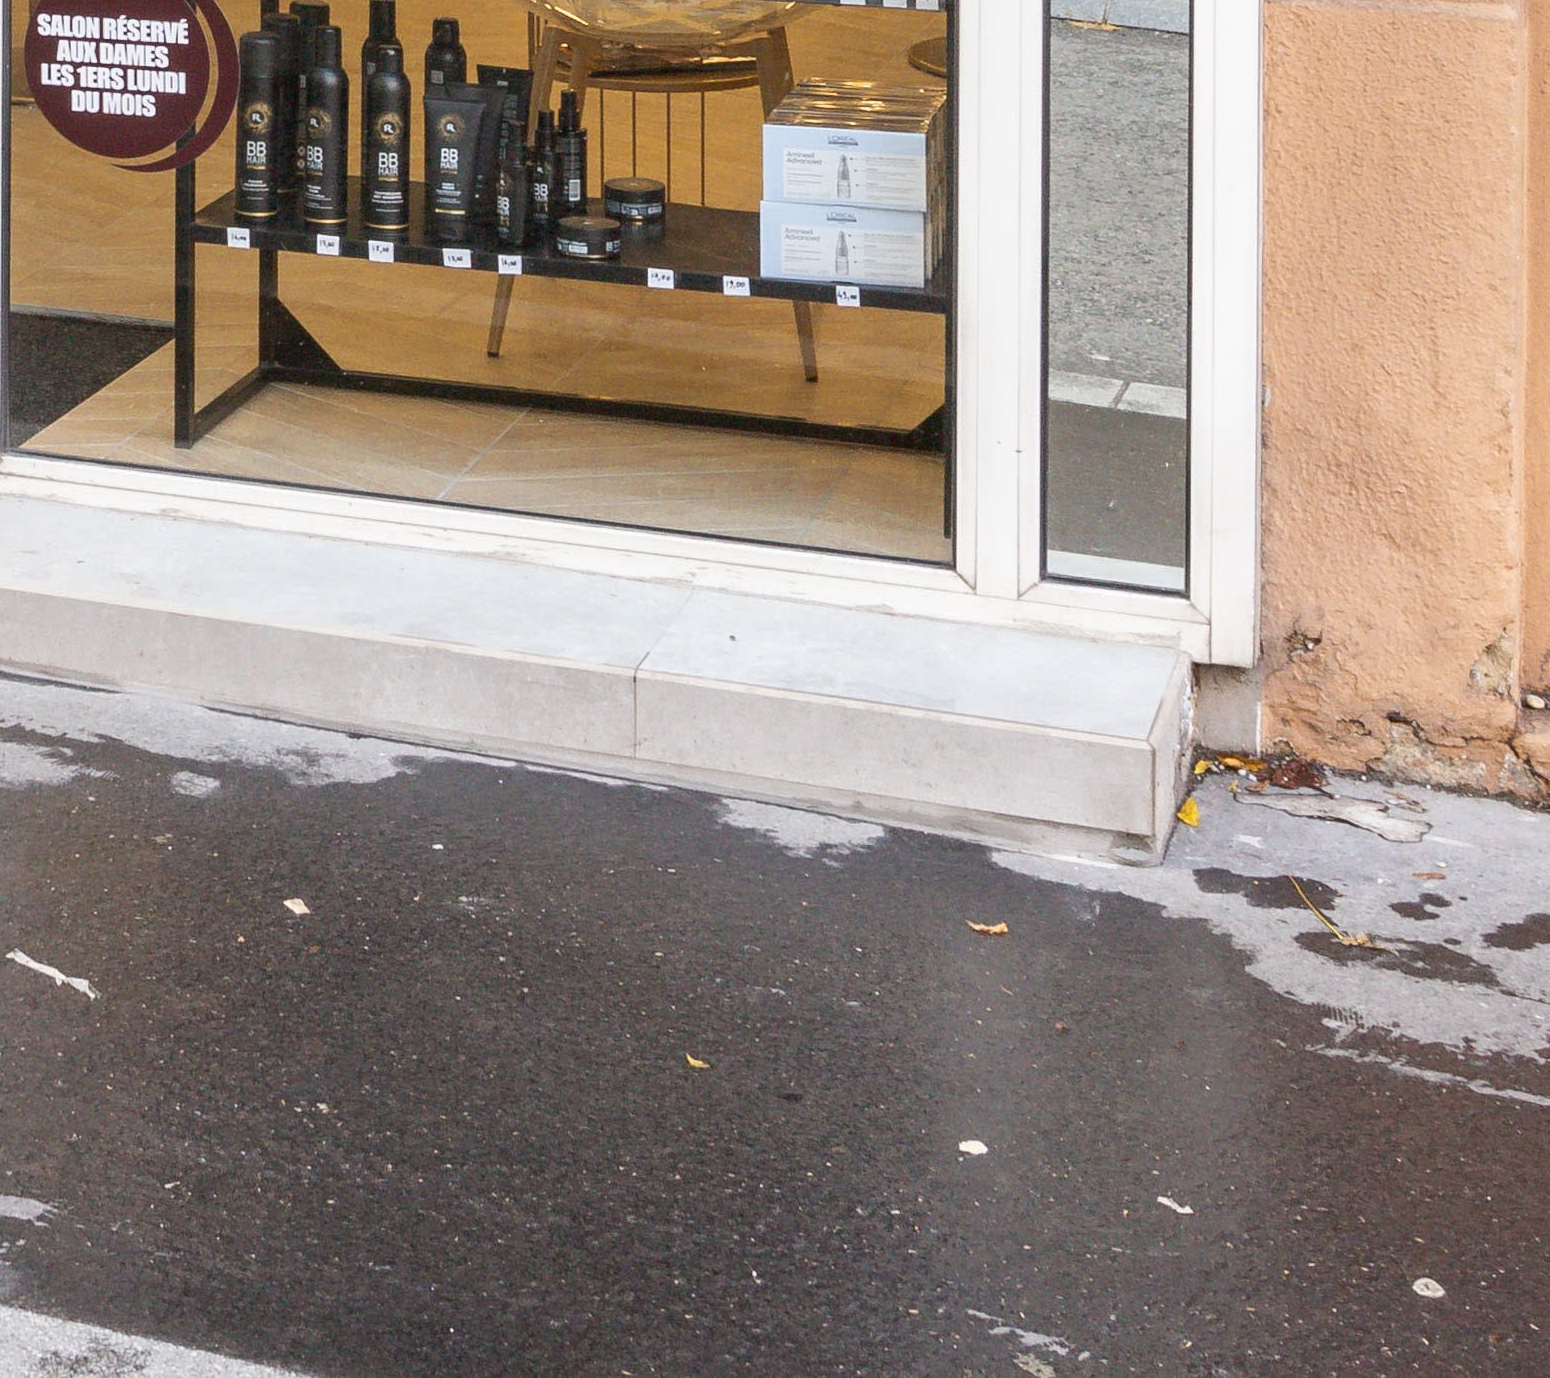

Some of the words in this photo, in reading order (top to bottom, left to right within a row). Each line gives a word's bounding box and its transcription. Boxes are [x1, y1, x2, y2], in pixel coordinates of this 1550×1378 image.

[37, 13, 100, 38] SALON
[102, 15, 189, 44] RÉSERVÉ
[57, 40, 98, 64] AUX
[99, 43, 169, 68] DAMES
[40, 63, 75, 87] LES
[76, 66, 124, 91] 1ERS
[127, 69, 187, 94] LUNDI
[71, 90, 100, 113] DU
[102, 93, 156, 117] MOIS
[246, 141, 267, 156] BB
[441, 148, 458, 162] BB
[246, 156, 266, 165] HAIR
[378, 152, 398, 167] BB
[441, 161, 458, 169] HAIR
[378, 167, 398, 175] HAIR
